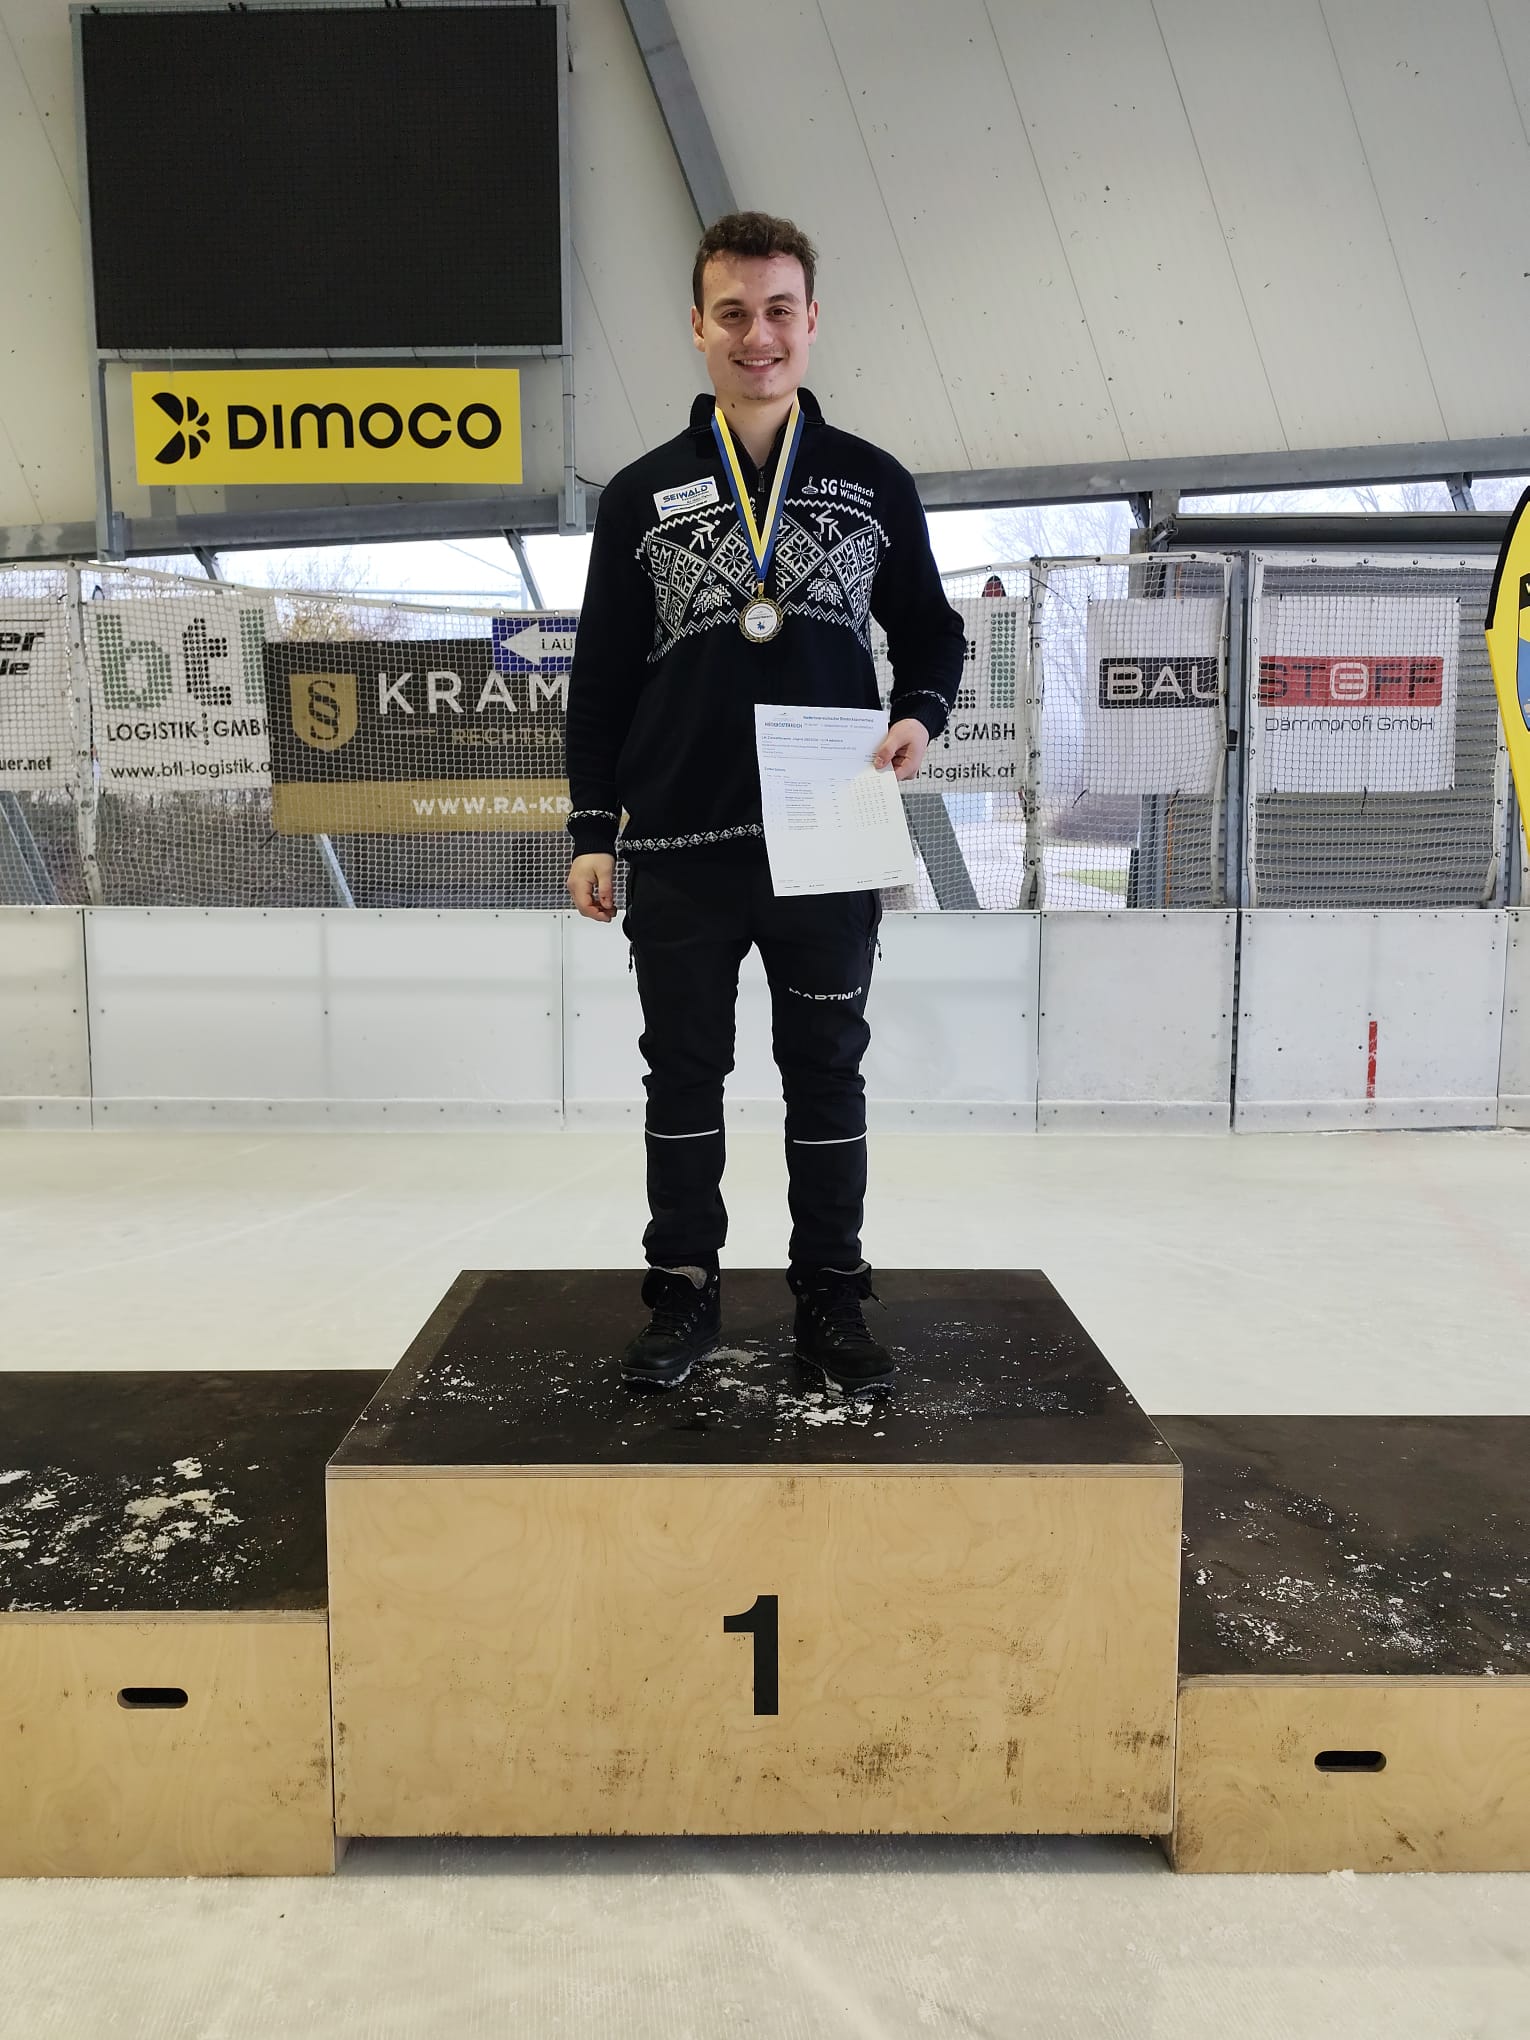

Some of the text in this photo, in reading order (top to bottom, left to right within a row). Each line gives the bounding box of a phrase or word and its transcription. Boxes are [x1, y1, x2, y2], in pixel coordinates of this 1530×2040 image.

[227, 402, 502, 449] DIMOCO
[663, 485, 708, 503] SEIWALD
[820, 478, 838, 495] SG
[840, 479, 874, 498] Umdasch
[840, 488, 872, 508] Winklarn
[542, 638, 576, 651] LAU
[378, 670, 570, 715] KRAM
[106, 720, 198, 742] LOGISTIK
[954, 723, 1016, 741] GMBH
[1265, 717, 1433, 734] Dämmprofi GmbH
[723, 1594, 779, 1716] 1
